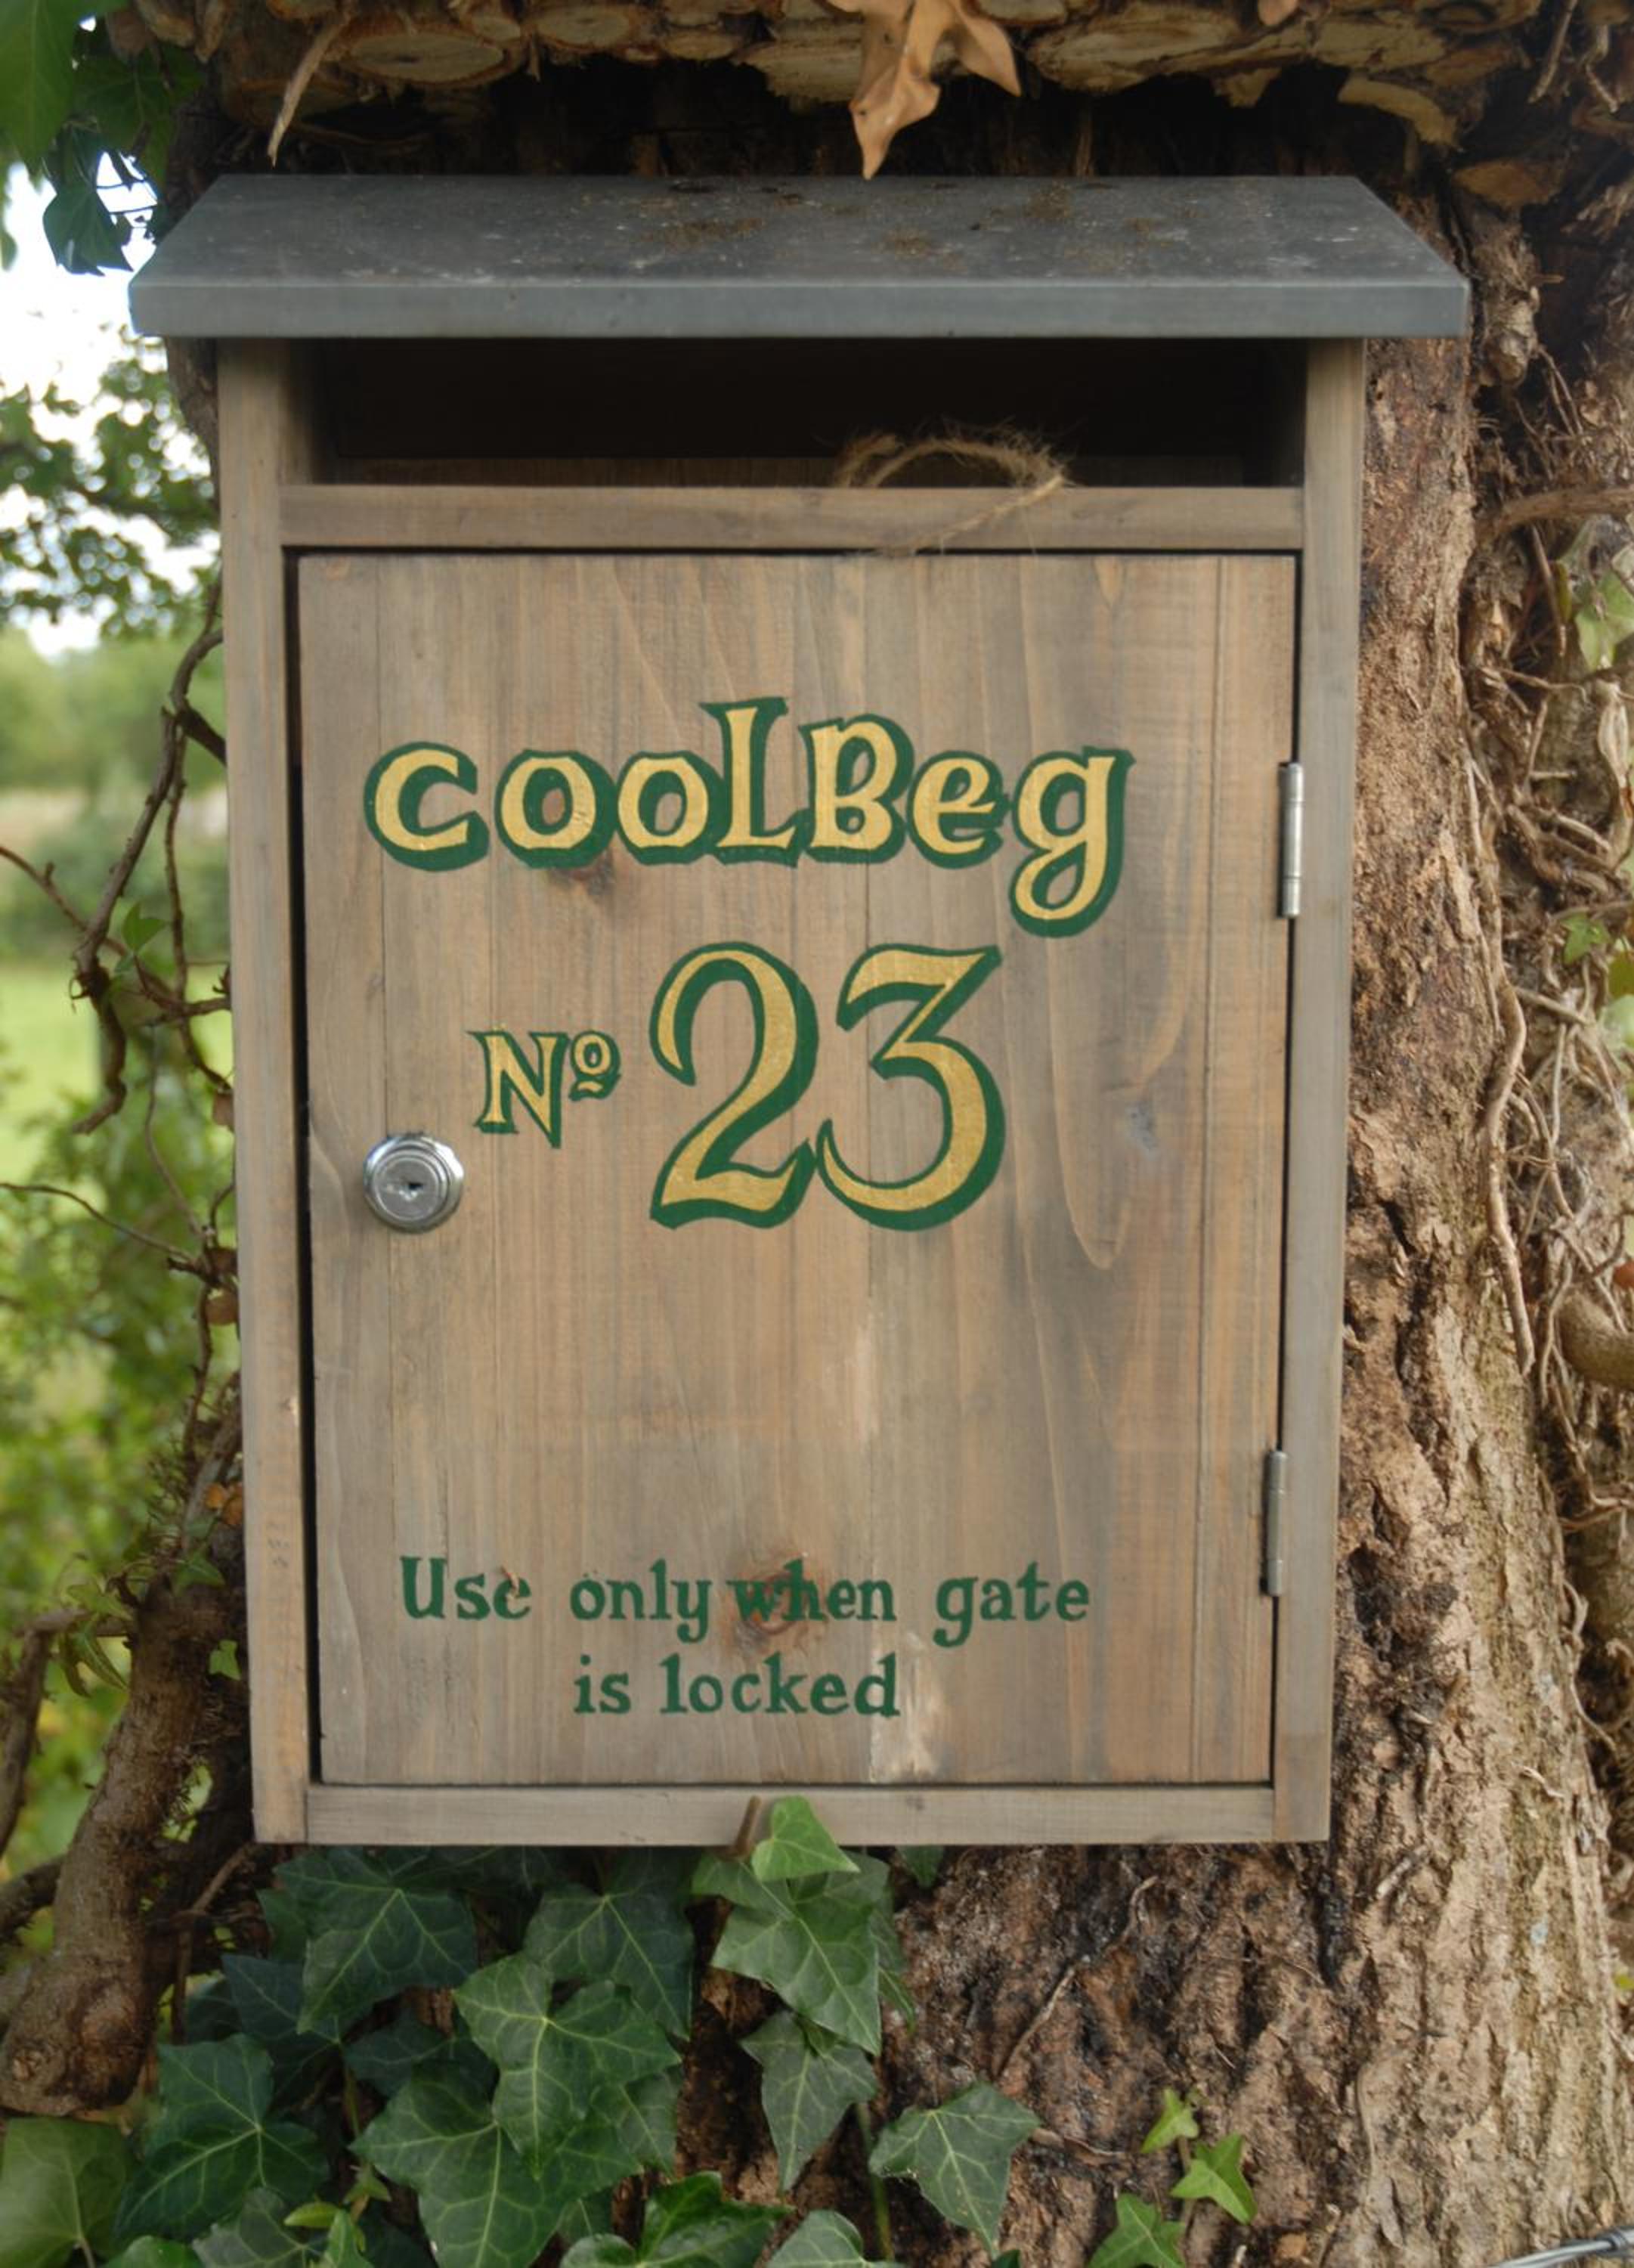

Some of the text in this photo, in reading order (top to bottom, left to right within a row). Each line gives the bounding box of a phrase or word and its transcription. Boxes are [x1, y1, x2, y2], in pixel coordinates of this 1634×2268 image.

[649, 942, 1005, 1232] 23
[401, 1555, 1089, 1648] Use only when gate
[574, 1652, 899, 1718] is locked
